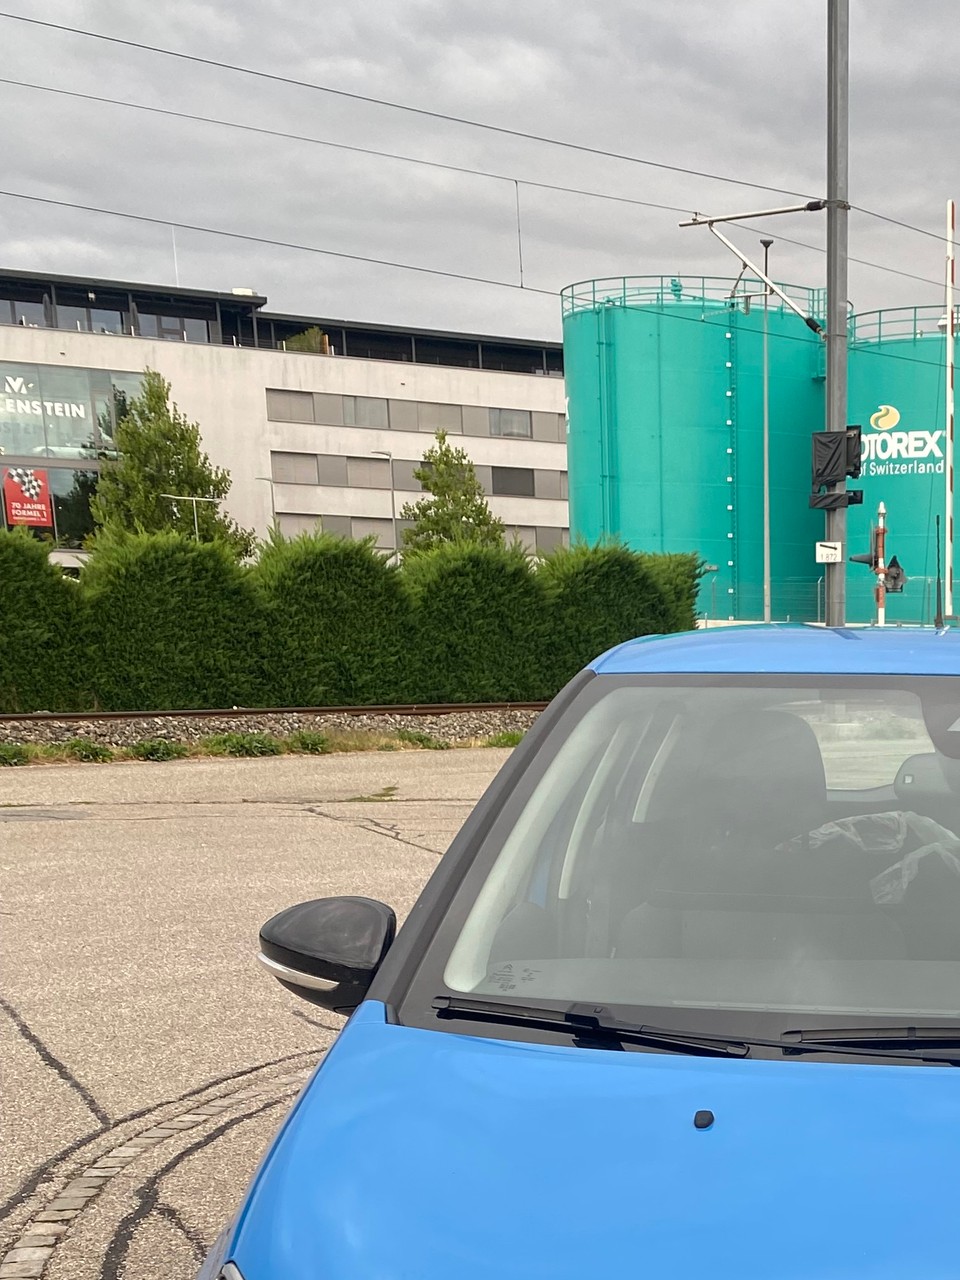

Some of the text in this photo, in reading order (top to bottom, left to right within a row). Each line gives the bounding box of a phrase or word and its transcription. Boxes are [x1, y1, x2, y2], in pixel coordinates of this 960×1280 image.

[861, 431, 944, 462] OTOREX
[869, 460, 944, 476] Switzerland
[22, 502, 46, 510] JAHRE
[11, 509, 41, 517] FORMEL
